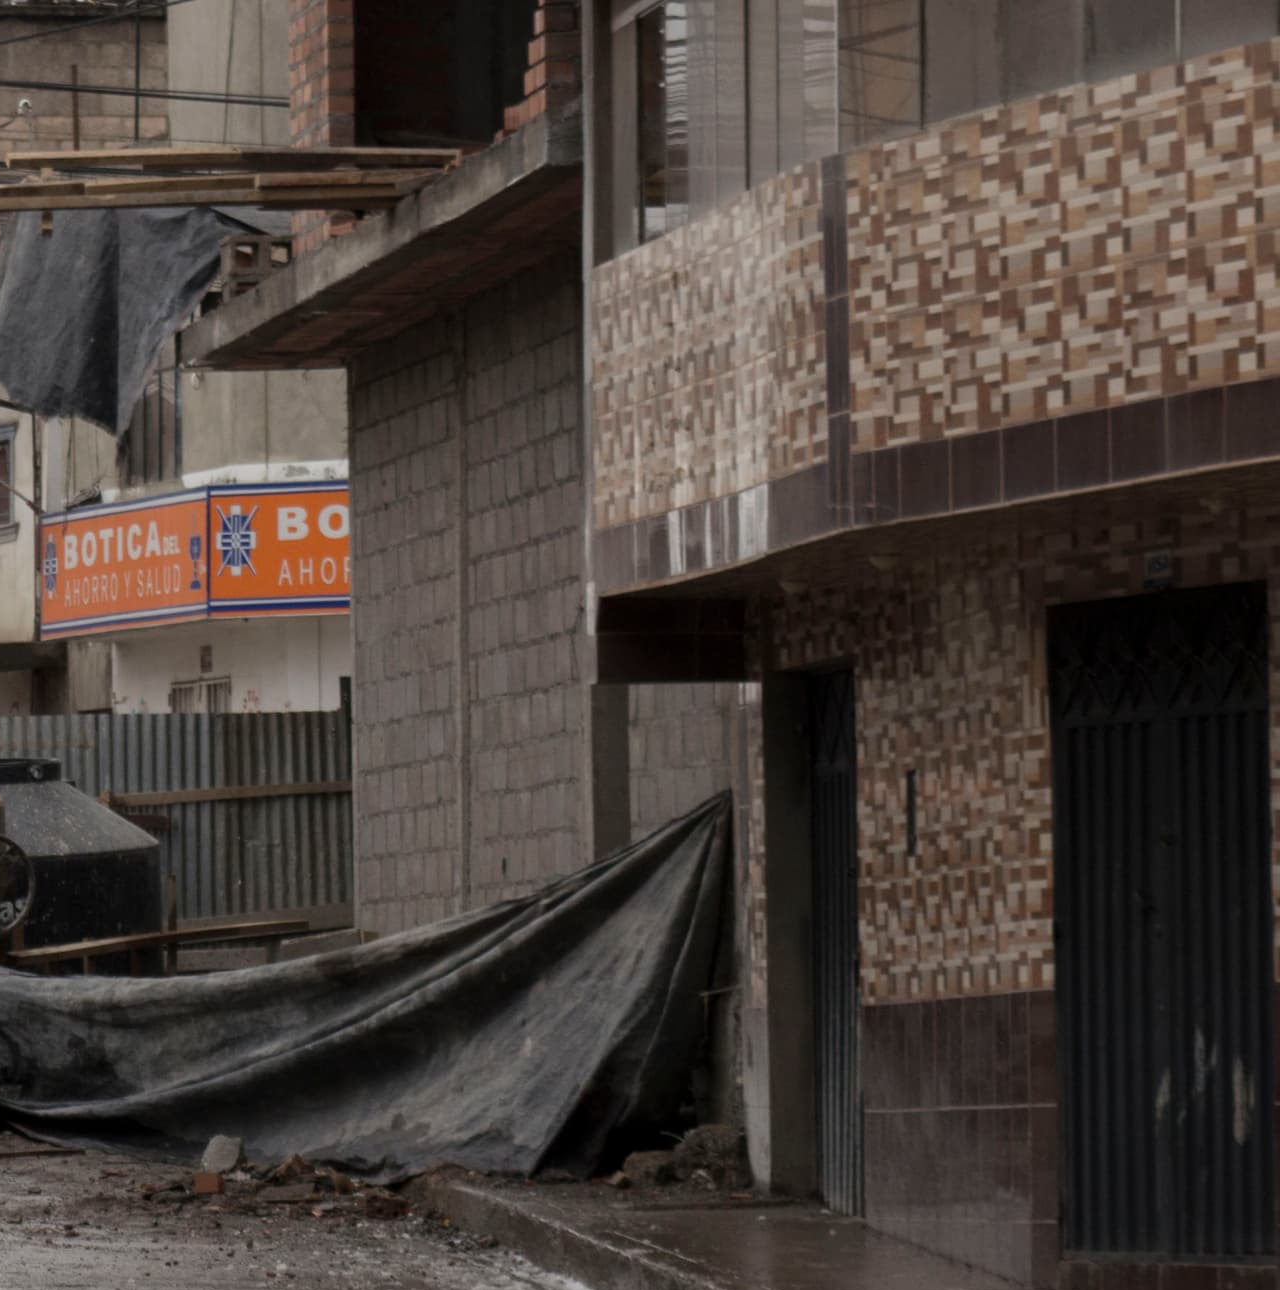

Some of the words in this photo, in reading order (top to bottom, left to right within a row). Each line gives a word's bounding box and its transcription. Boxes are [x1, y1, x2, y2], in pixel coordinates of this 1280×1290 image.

[63, 520, 162, 571] BOTICA
[162, 534, 181, 557] DEL
[63, 574, 118, 608] AHORRO
[123, 577, 131, 598] Y
[136, 564, 181, 598] SALUD
